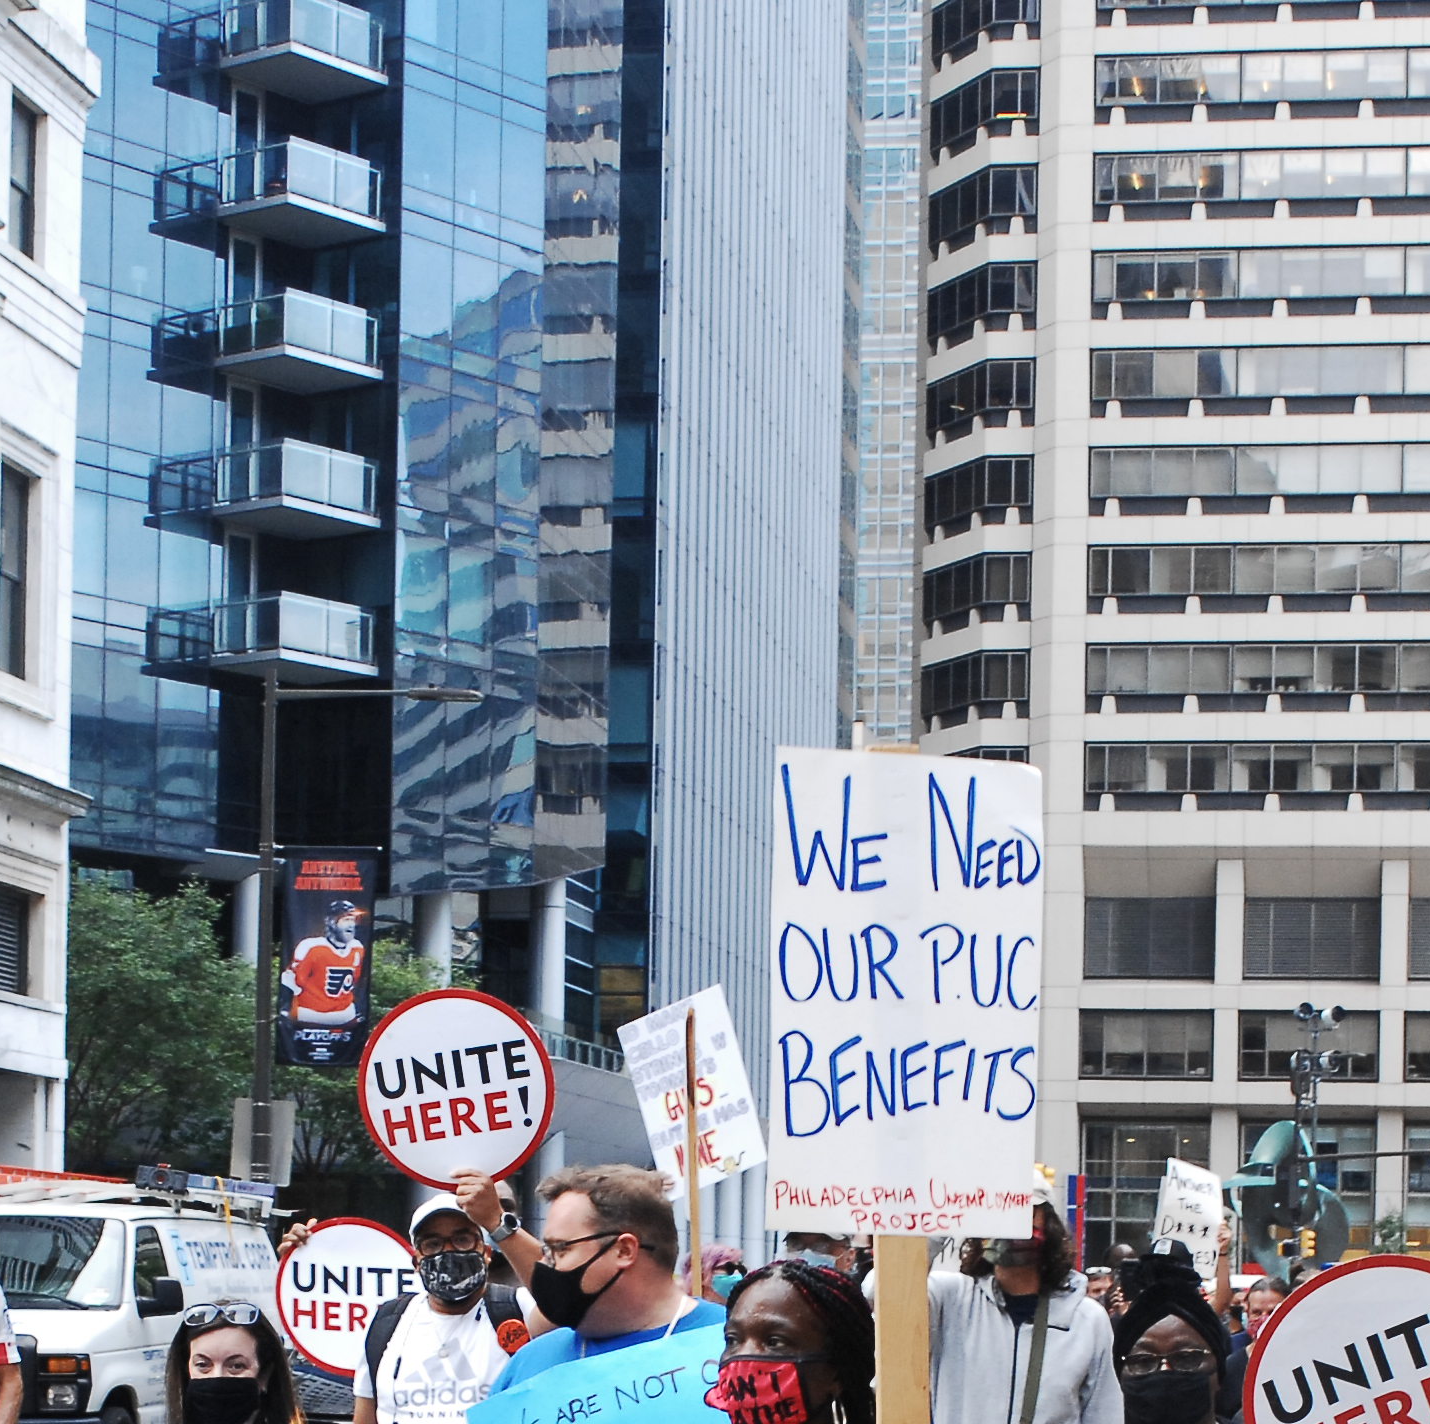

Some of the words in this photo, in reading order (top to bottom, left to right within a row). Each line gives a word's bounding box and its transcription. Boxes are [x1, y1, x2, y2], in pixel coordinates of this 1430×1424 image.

[781, 763, 888, 892] WE
[928, 771, 1041, 892] NEED
[778, 921, 904, 1002] OUR
[374, 1039, 531, 1100] UNITE
[778, 1030, 1036, 1137] BENEFITS
[382, 1085, 533, 1147] HERE!
[674, 1130, 721, 1177] NNE
[773, 1180, 917, 1210] PHILADELPHIA
[1178, 1197, 1203, 1215] THE
[851, 1209, 965, 1233] PROJECT
[292, 1260, 420, 1297] UNITE
[292, 1298, 368, 1333] HER
[393, 1379, 491, 1408] adidas
[615, 1366, 686, 1411] NOT
